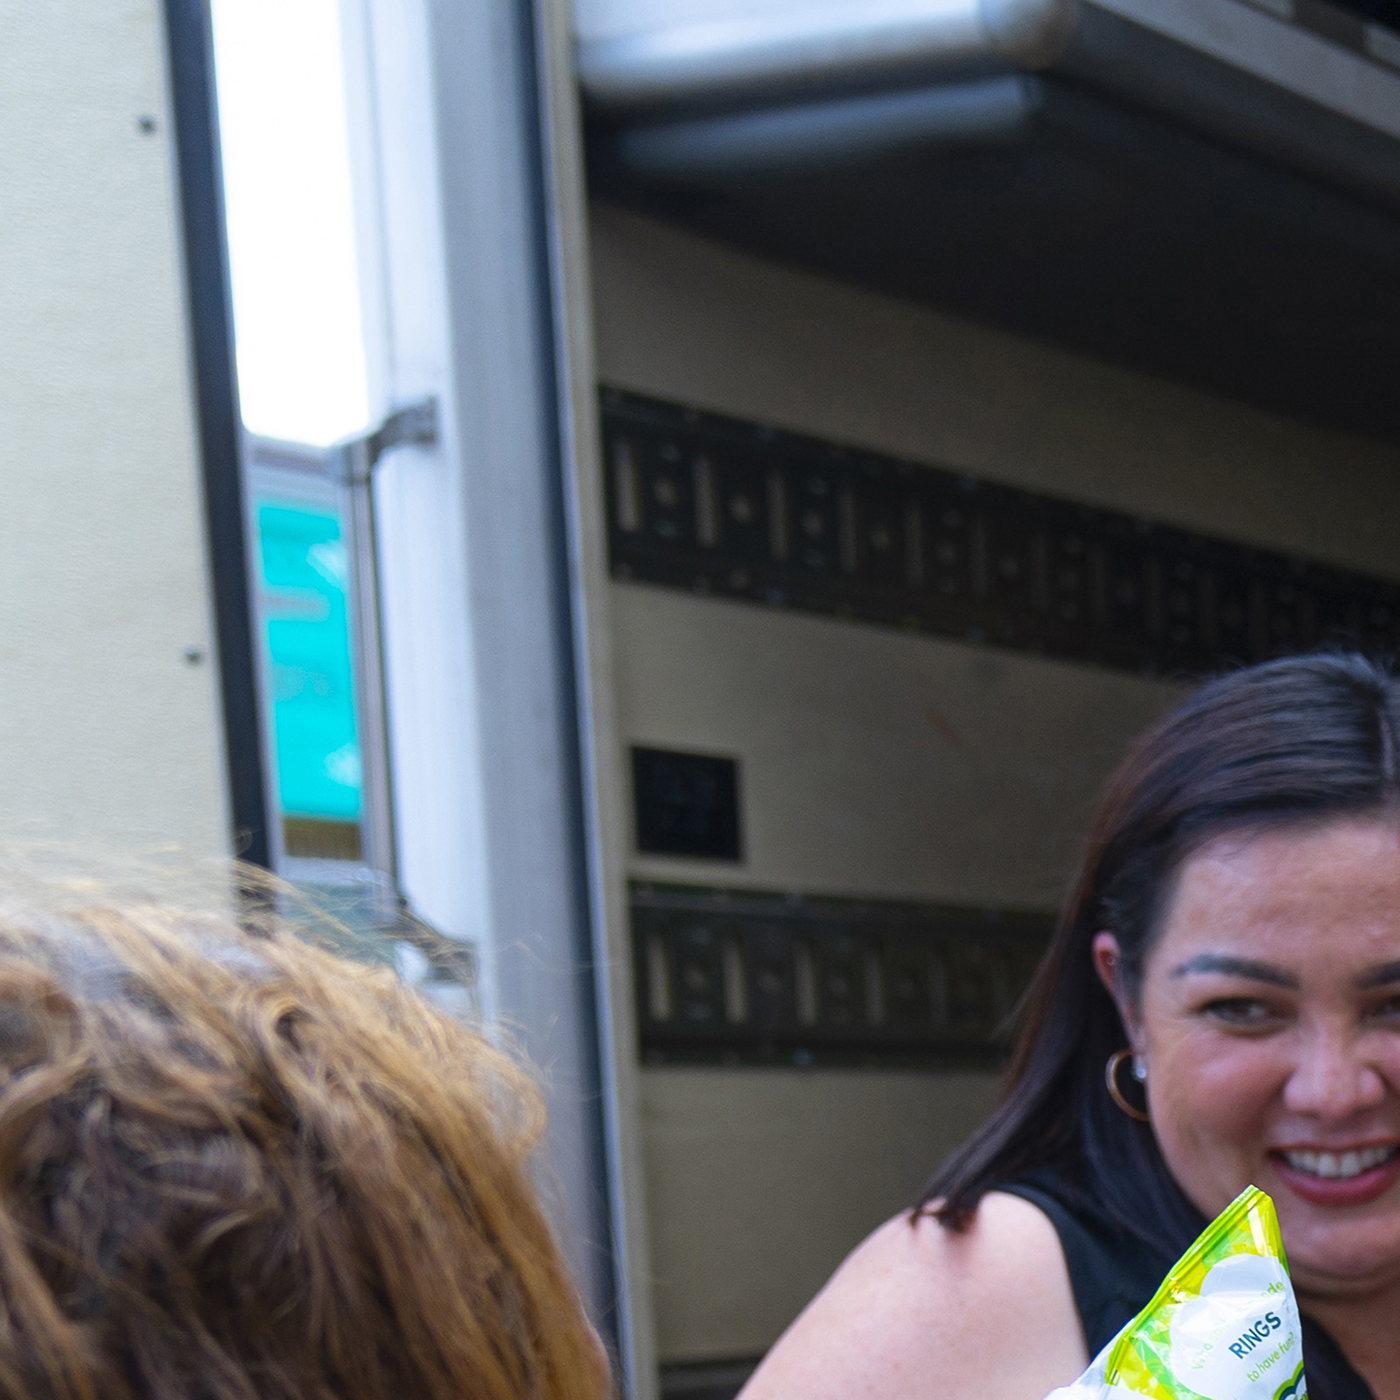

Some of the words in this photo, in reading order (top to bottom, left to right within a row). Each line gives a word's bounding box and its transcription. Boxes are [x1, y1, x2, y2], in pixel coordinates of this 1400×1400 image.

[1228, 1312, 1281, 1359] RINGS
[1247, 1371, 1259, 1382] to
[1256, 1351, 1280, 1373] have
